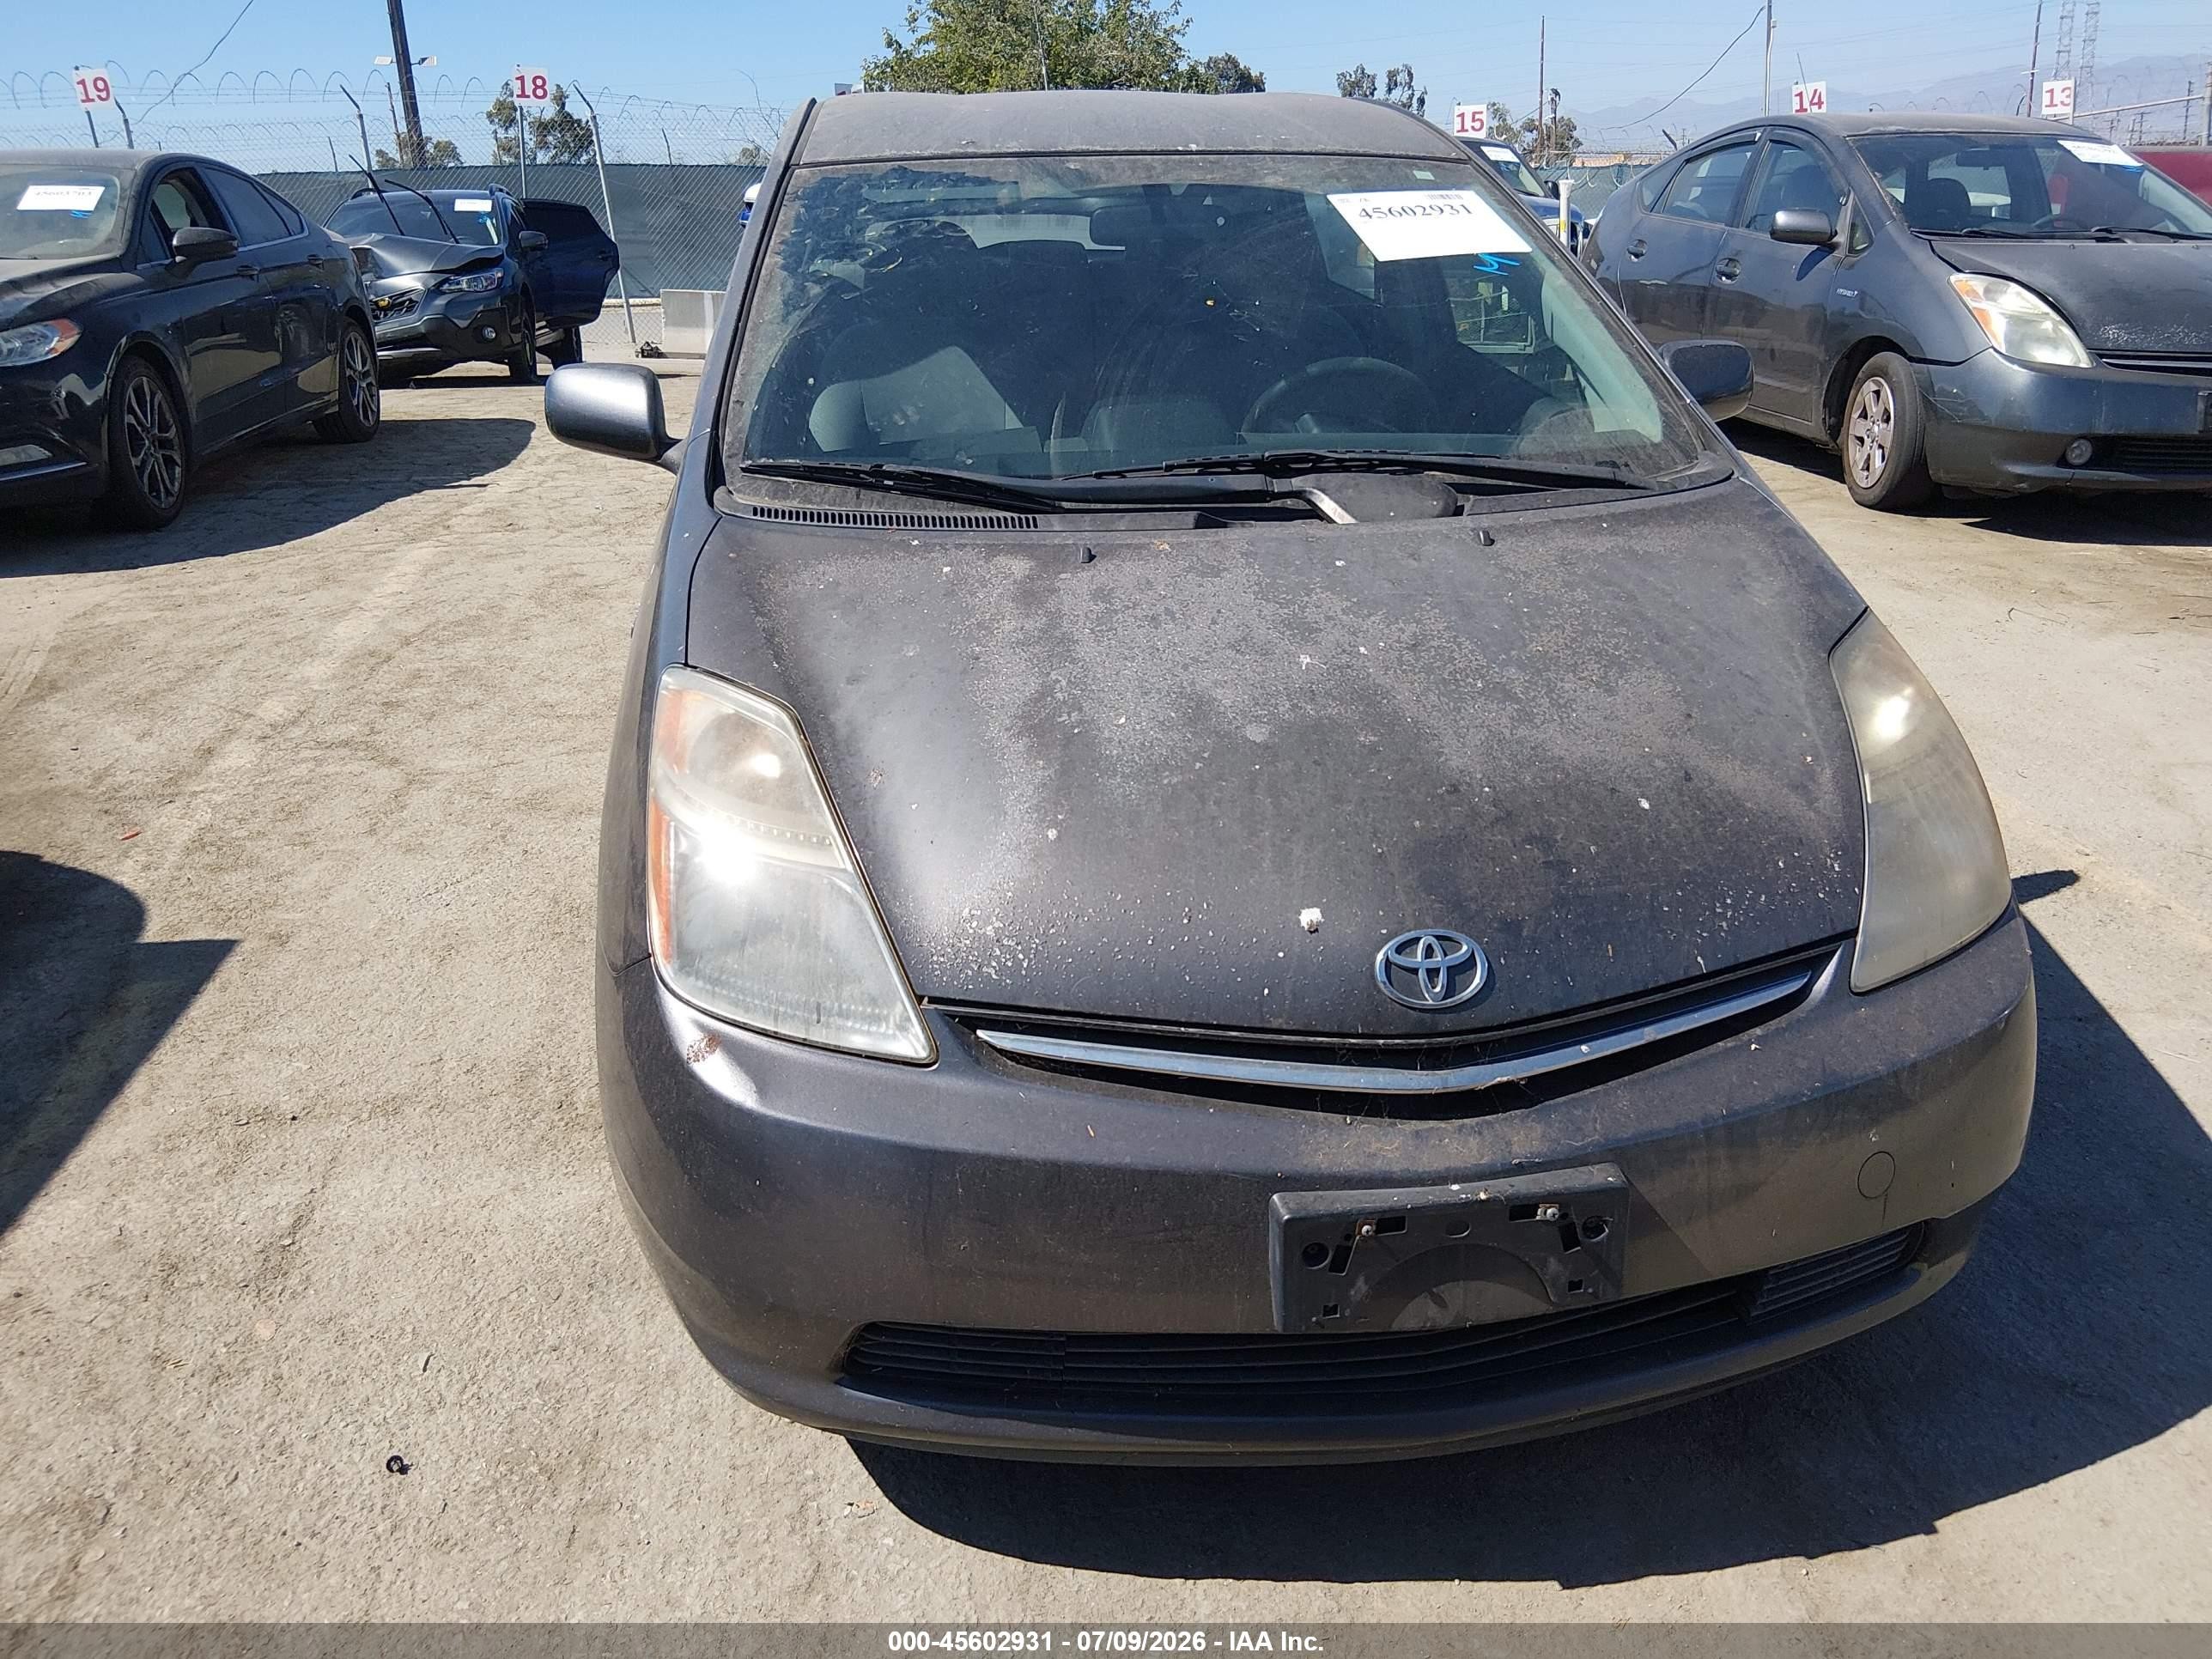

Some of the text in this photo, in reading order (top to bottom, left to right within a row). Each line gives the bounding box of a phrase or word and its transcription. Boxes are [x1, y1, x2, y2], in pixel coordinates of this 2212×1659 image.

[76, 76, 110, 103] 19
[515, 75, 548, 100] 18
[2045, 87, 2071, 107] 13
[1795, 88, 1824, 112] 14
[1455, 111, 1485, 133] 15
[1358, 204, 1473, 219] 45602931
